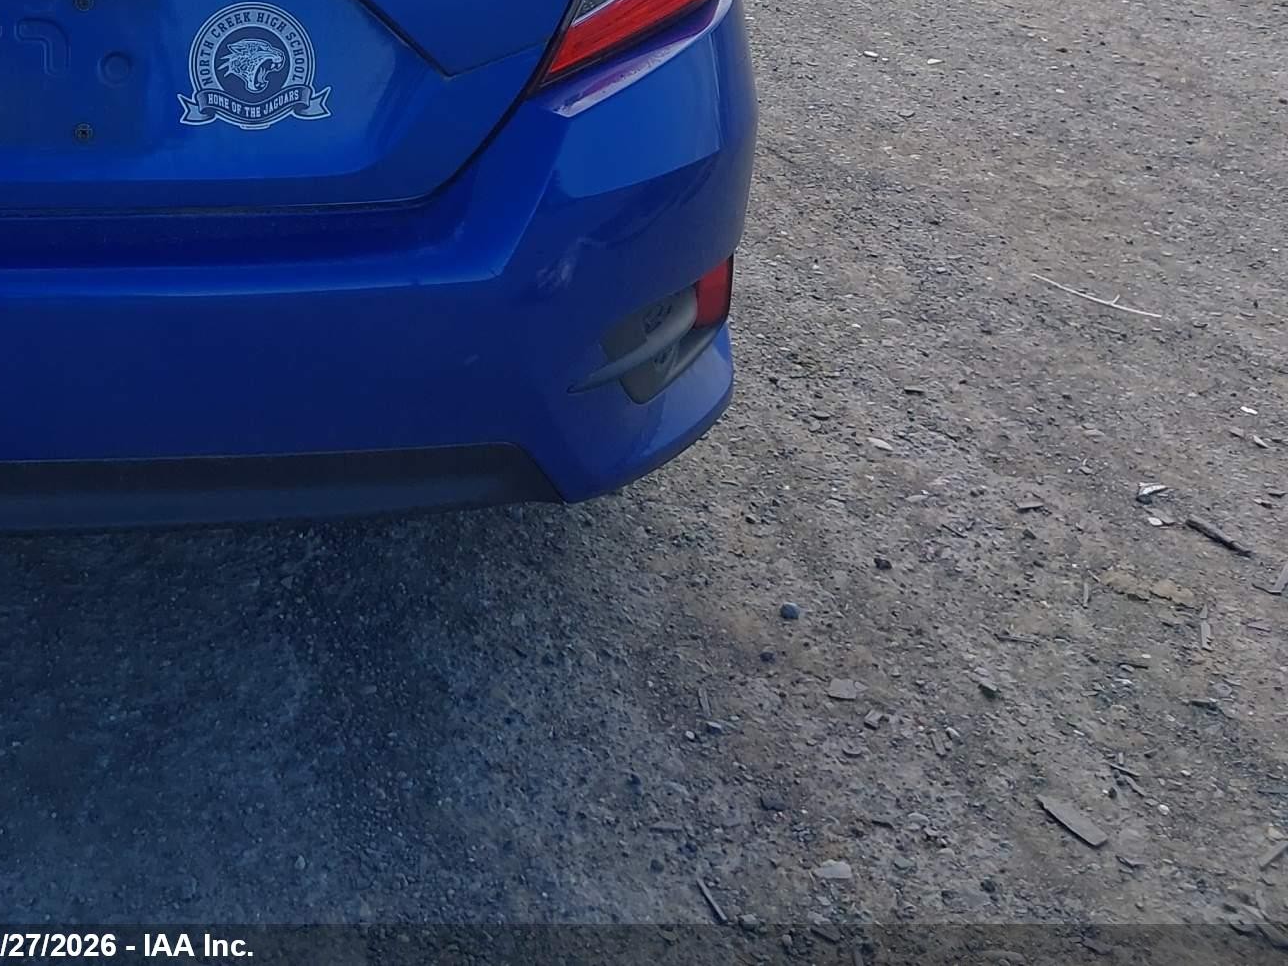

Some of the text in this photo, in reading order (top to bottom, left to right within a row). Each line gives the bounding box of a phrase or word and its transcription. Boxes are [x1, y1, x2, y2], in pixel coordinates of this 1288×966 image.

[199, 12, 305, 86] NORTH CREEK HIGH SCHOOL
[207, 89, 300, 118] HOME OF THE JAGUARS
